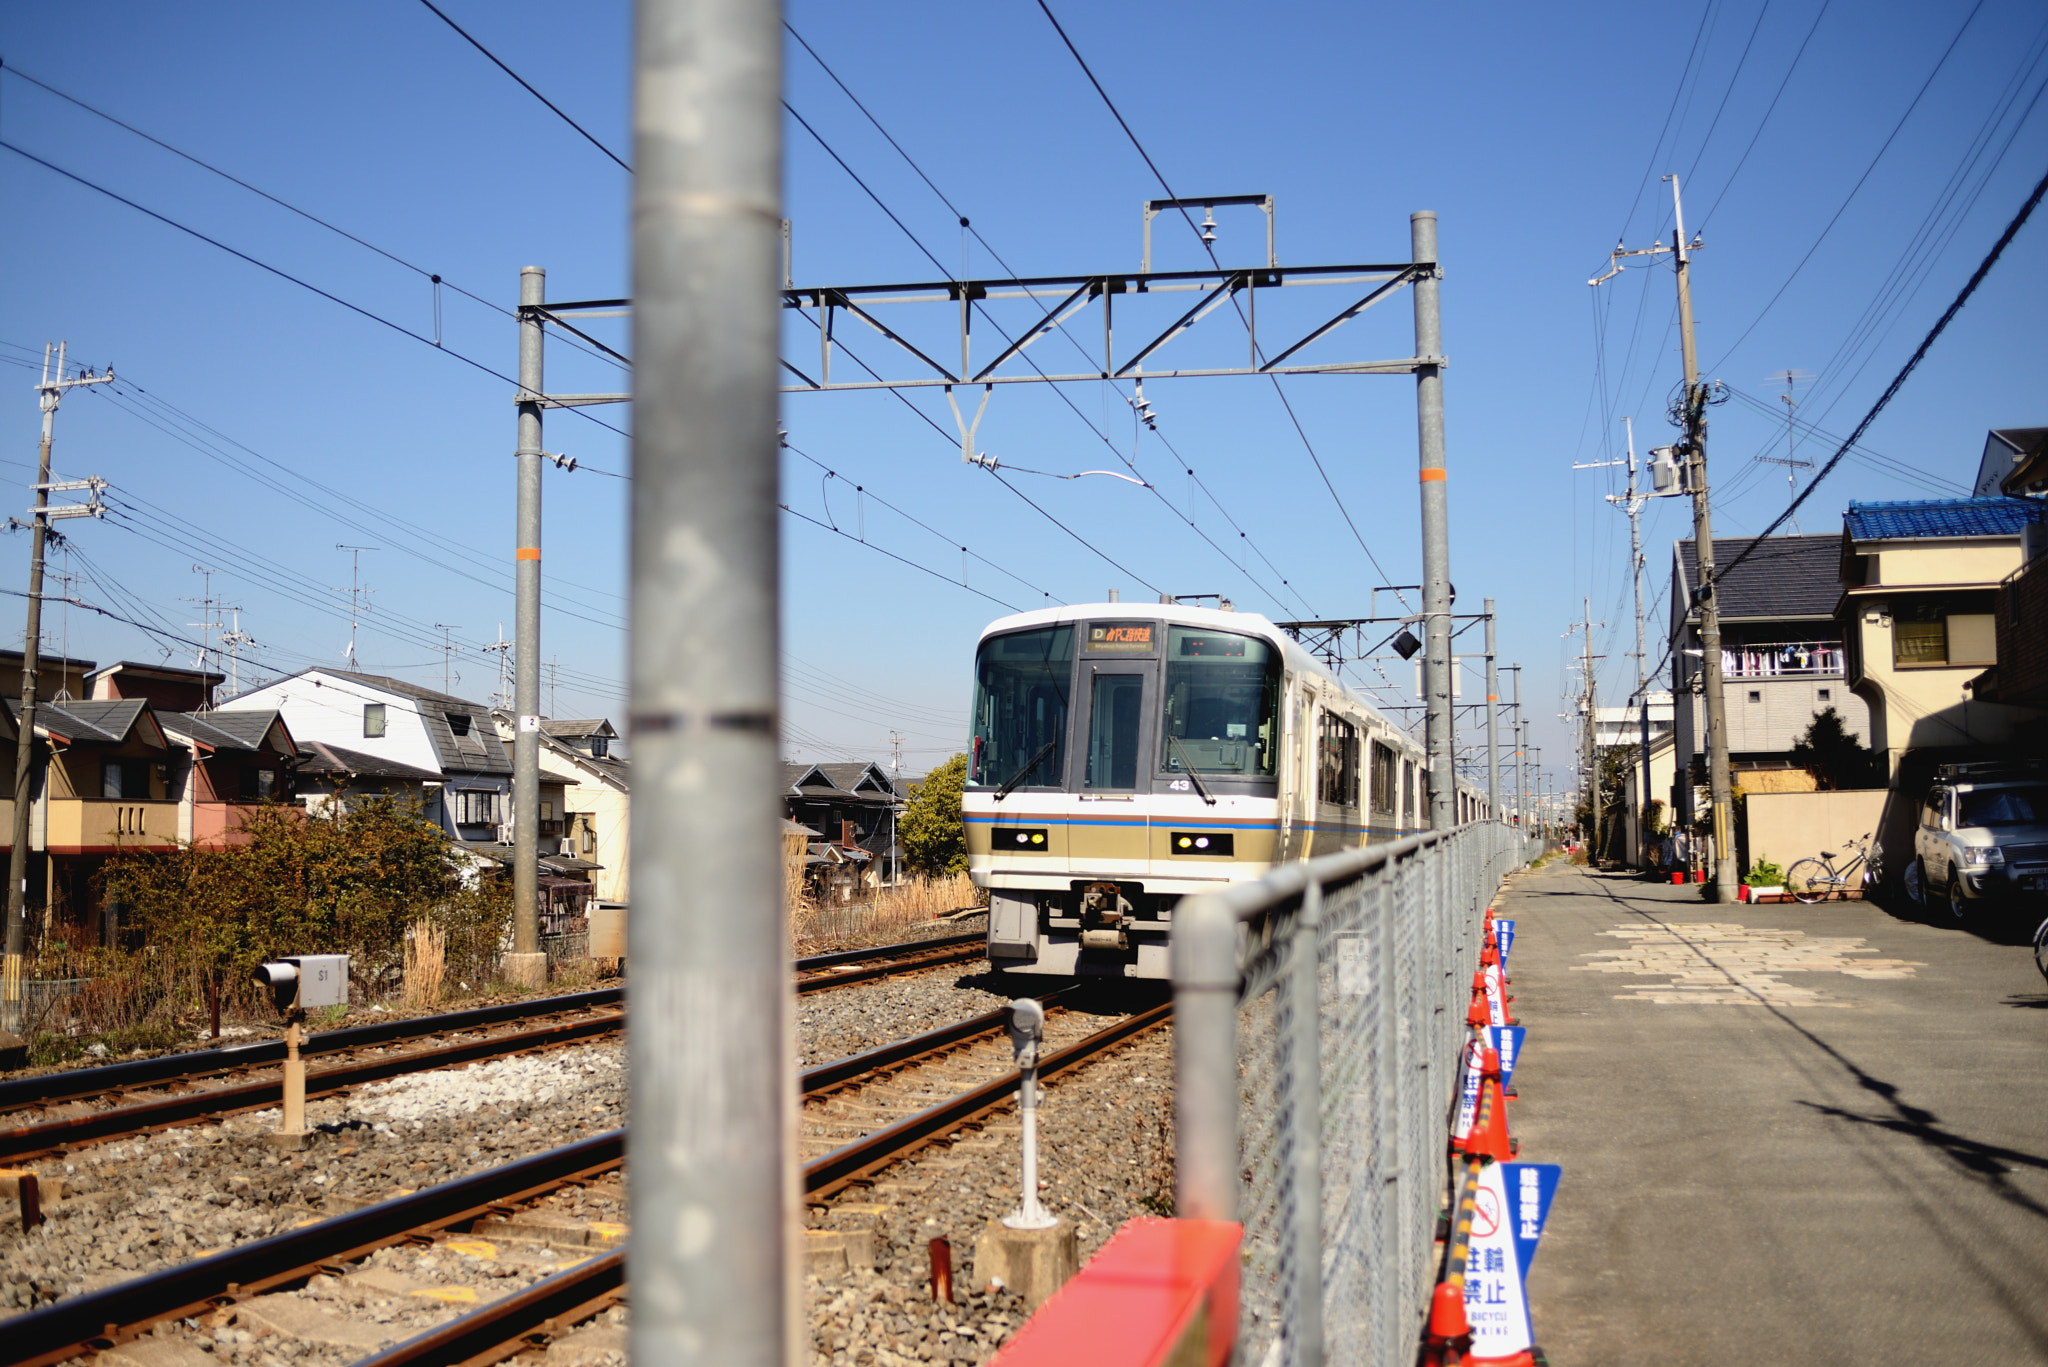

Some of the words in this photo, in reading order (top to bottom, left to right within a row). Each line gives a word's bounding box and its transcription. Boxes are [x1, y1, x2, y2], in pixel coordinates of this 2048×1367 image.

[1094, 629, 1104, 639] D
[529, 718, 535, 726] 2
[1169, 780, 1190, 791] 43
